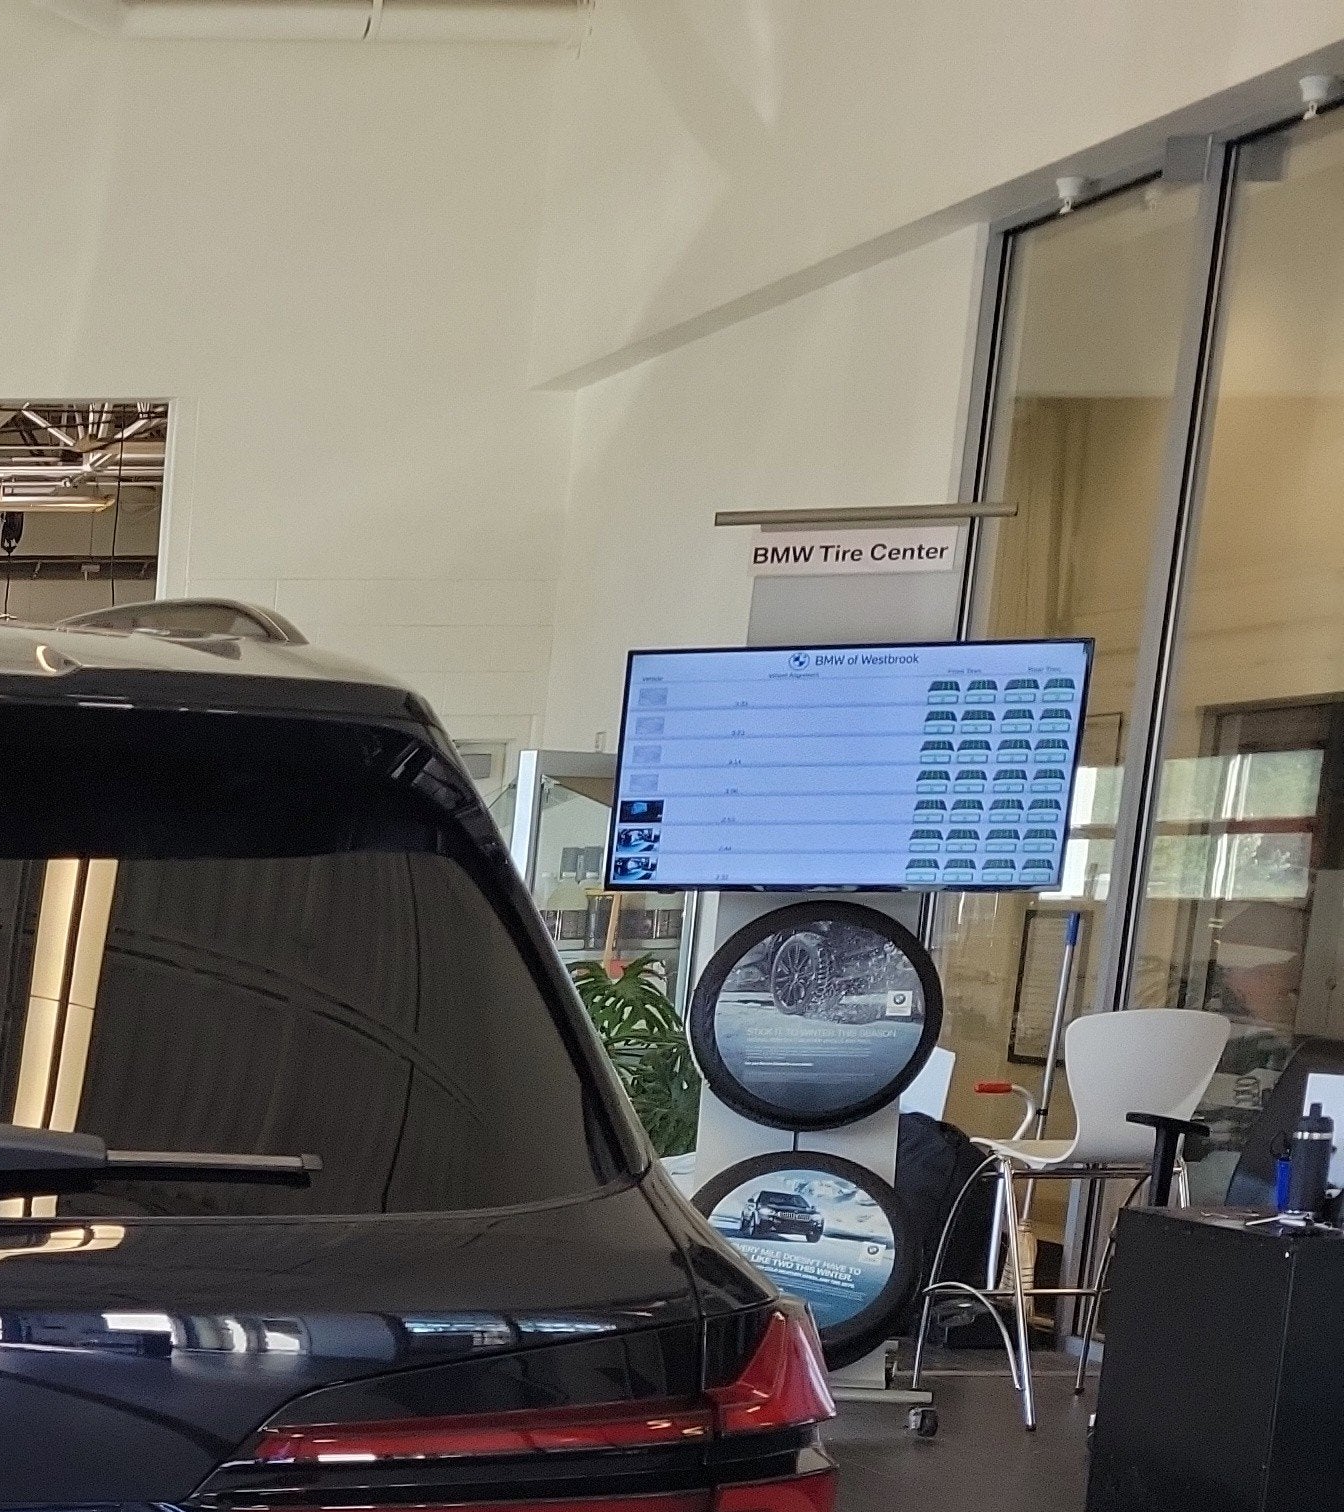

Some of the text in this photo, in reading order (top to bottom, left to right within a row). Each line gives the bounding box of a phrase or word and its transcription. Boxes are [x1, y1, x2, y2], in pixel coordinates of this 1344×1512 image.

[753, 543, 949, 564] BMW Tire Center
[815, 653, 919, 666] BMW of Westbrook
[750, 1254, 771, 1265] LIKE
[773, 1259, 794, 1269] TWO
[796, 1264, 816, 1274] THIS
[817, 1268, 853, 1282] WINTER.
[783, 1252, 821, 1266] DOESN'T
[823, 1261, 847, 1273] HAVE
[849, 1267, 862, 1275] TO
